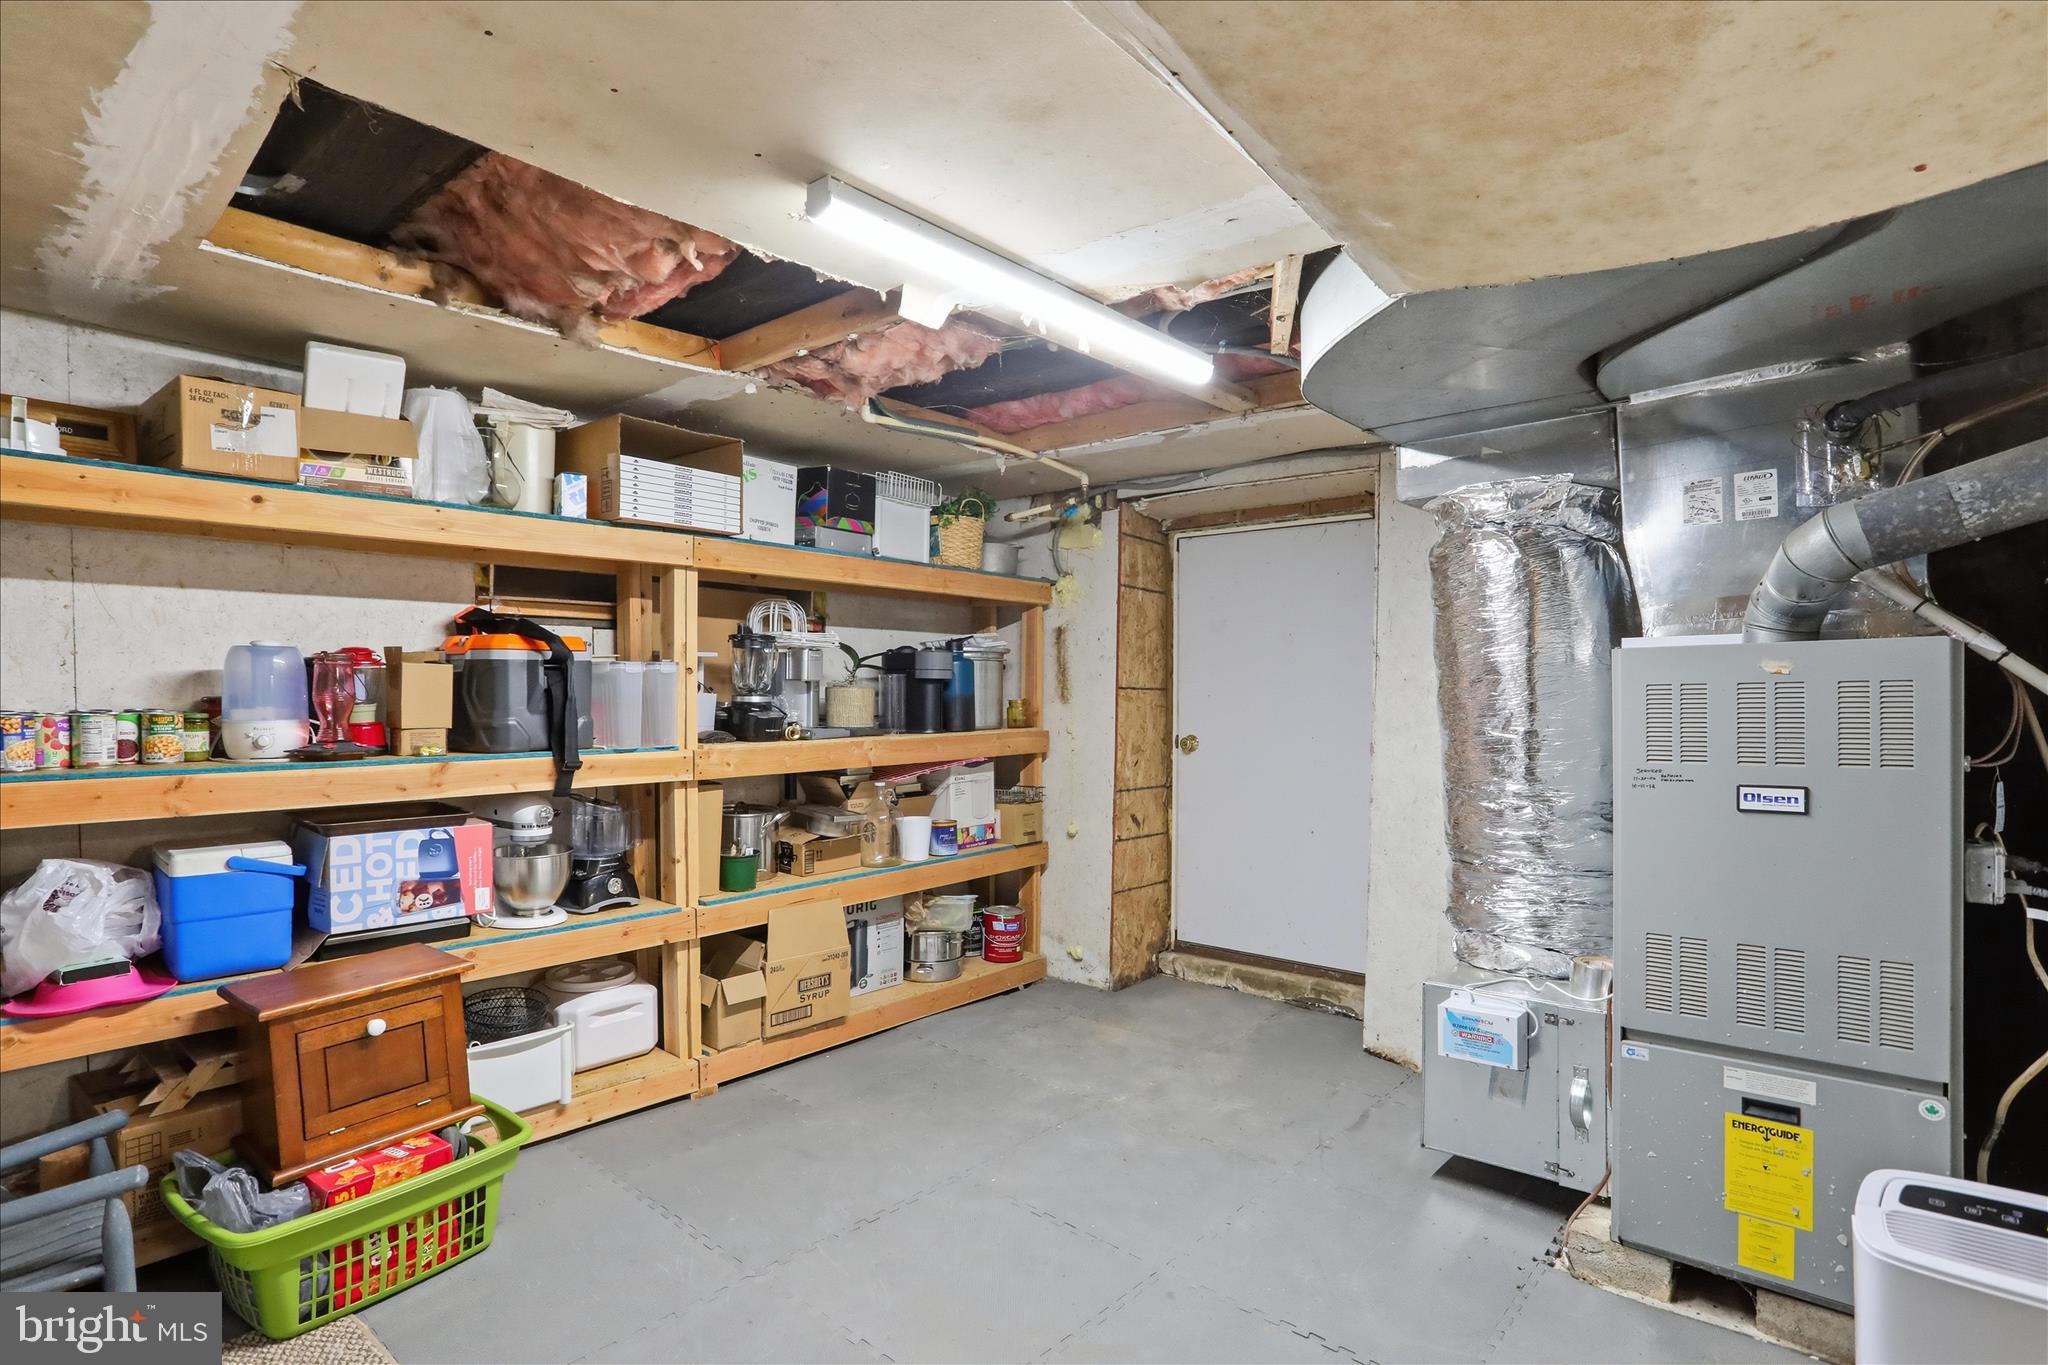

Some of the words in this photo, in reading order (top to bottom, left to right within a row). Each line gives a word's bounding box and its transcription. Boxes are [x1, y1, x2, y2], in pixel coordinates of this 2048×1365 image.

[1743, 792, 1799, 804] Olsen
[365, 834, 393, 902] HOT
[331, 837, 363, 930] ICED
[800, 989, 830, 1003] SYRUP
[1732, 1119, 1801, 1142] ENERGYGUIDE
